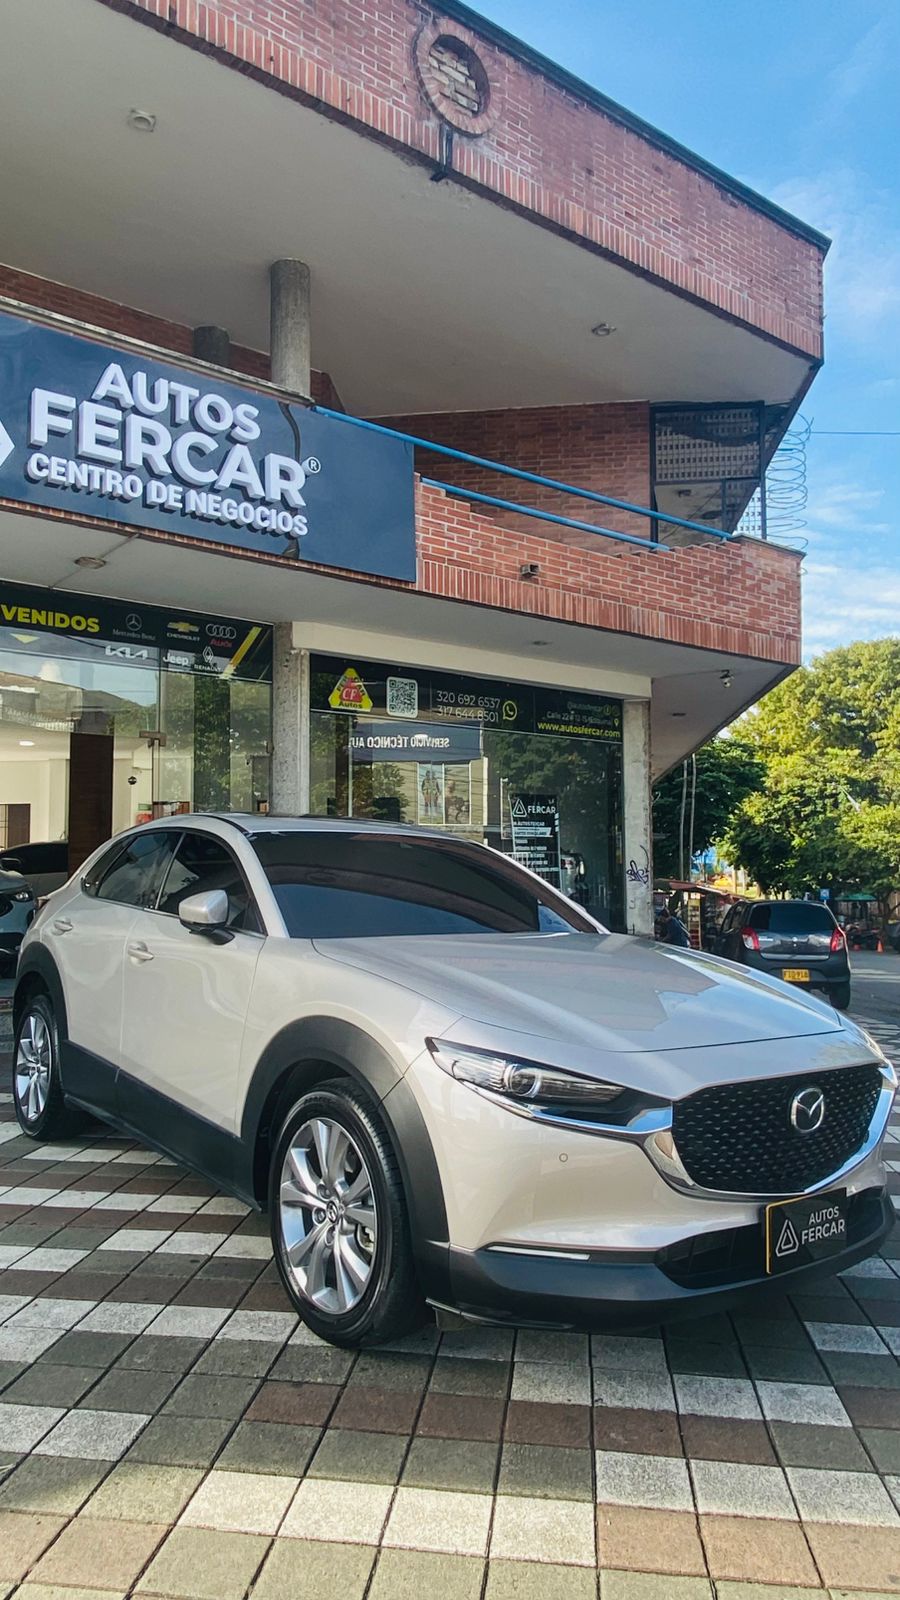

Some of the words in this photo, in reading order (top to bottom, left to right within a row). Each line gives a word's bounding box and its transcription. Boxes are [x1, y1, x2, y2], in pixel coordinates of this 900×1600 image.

[91, 363, 261, 443] AUTOS
[27, 453, 143, 500] CENTRO
[147, 480, 183, 511] DE
[185, 489, 308, 536] NEGOCIOS
[1, 604, 100, 633] VENIDOS
[105, 645, 148, 660] KIA
[162, 653, 189, 667] Jeep
[436, 690, 455, 703] 320
[457, 694, 476, 706] 692
[478, 696, 500, 709] 6537
[436, 704, 453, 717] 317
[455, 707, 475, 719] 644
[477, 710, 499, 723] 8501
[527, 805, 556, 814] FERCAR
[808, 1206, 839, 1225] AUTOS
[801, 1219, 845, 1245] FERCAR
